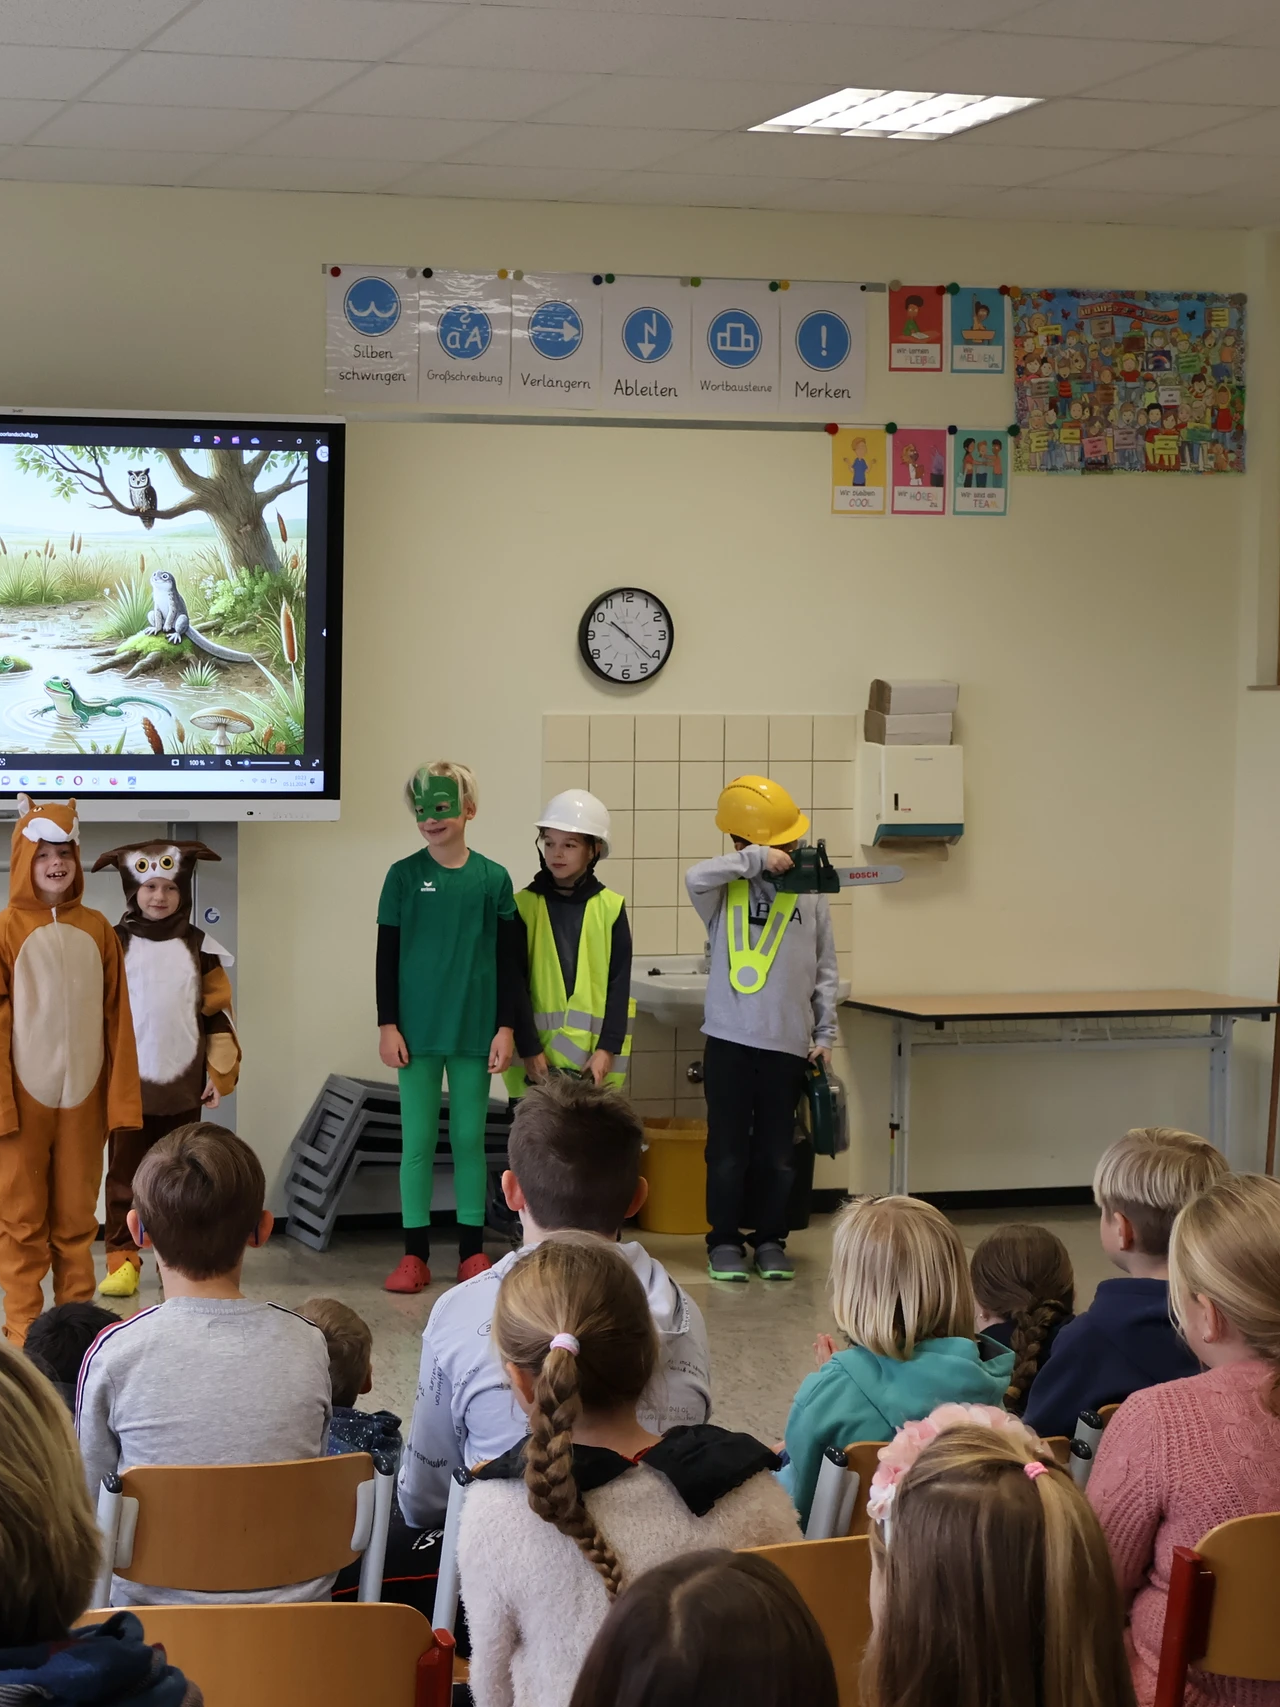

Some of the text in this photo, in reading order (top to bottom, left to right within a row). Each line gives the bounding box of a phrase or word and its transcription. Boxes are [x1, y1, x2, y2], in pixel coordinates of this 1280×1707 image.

[353, 345, 392, 359] Silben
[338, 370, 406, 385] schwingen
[427, 370, 503, 385] Großschreibung
[520, 372, 591, 392] Verlängern
[614, 378, 678, 398] Ableiten
[700, 380, 772, 393] Wortbausteine
[795, 381, 851, 399] Merken
[621, 592, 634, 602] 12
[606, 599, 613, 609] 11
[644, 598, 648, 608] 1
[593, 612, 605, 622] 10
[653, 612, 662, 622] 2
[588, 630, 595, 640] 9
[658, 630, 666, 640] 3
[592, 649, 600, 659] 8
[652, 650, 660, 660] 4
[604, 663, 613, 674] 7
[640, 663, 648, 673] 5
[622, 669, 630, 679] 6
[849, 871, 878, 879] BOSCH
